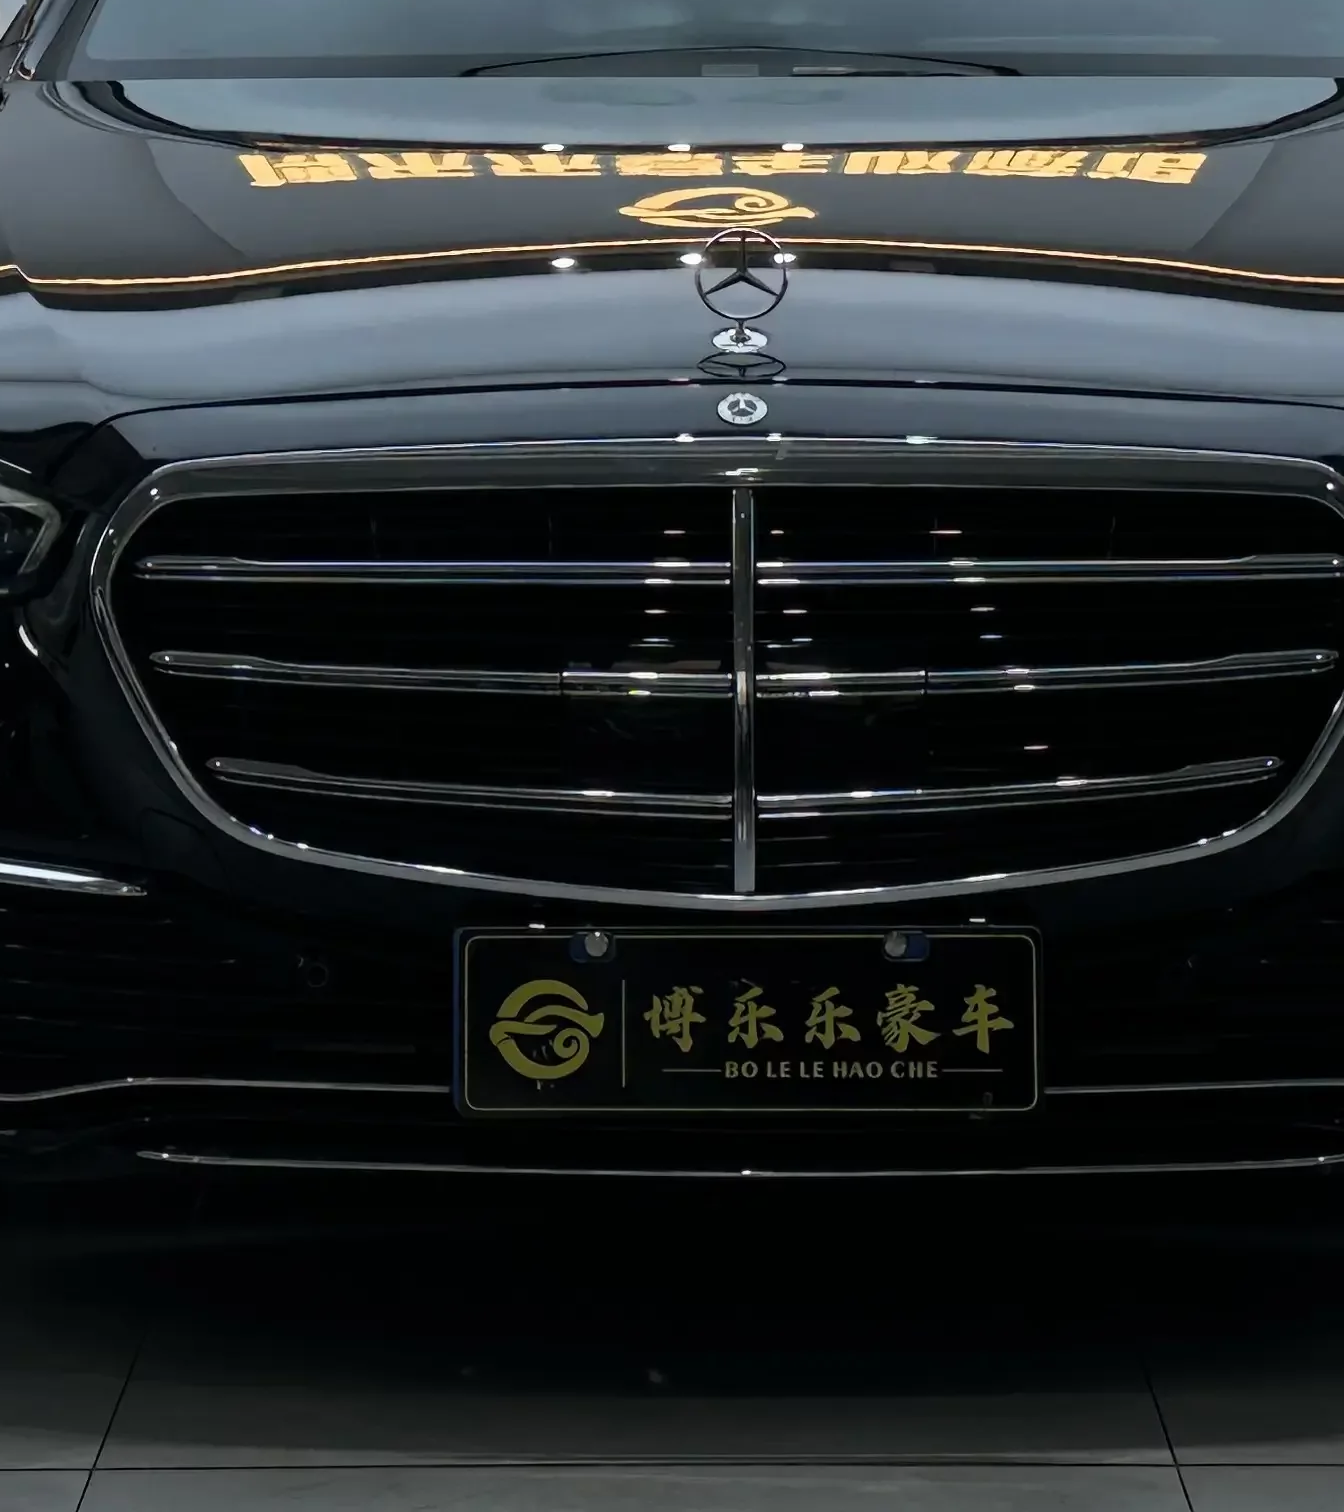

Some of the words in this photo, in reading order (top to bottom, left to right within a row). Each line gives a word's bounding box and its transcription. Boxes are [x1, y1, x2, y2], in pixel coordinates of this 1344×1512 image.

[643, 983, 1015, 1054] 博乐乐豪车
[724, 1061, 759, 1079] BO
[767, 1061, 792, 1079] LE
[800, 1061, 825, 1079] LE
[833, 1061, 882, 1079] HAO
[890, 1061, 939, 1079] CHE
